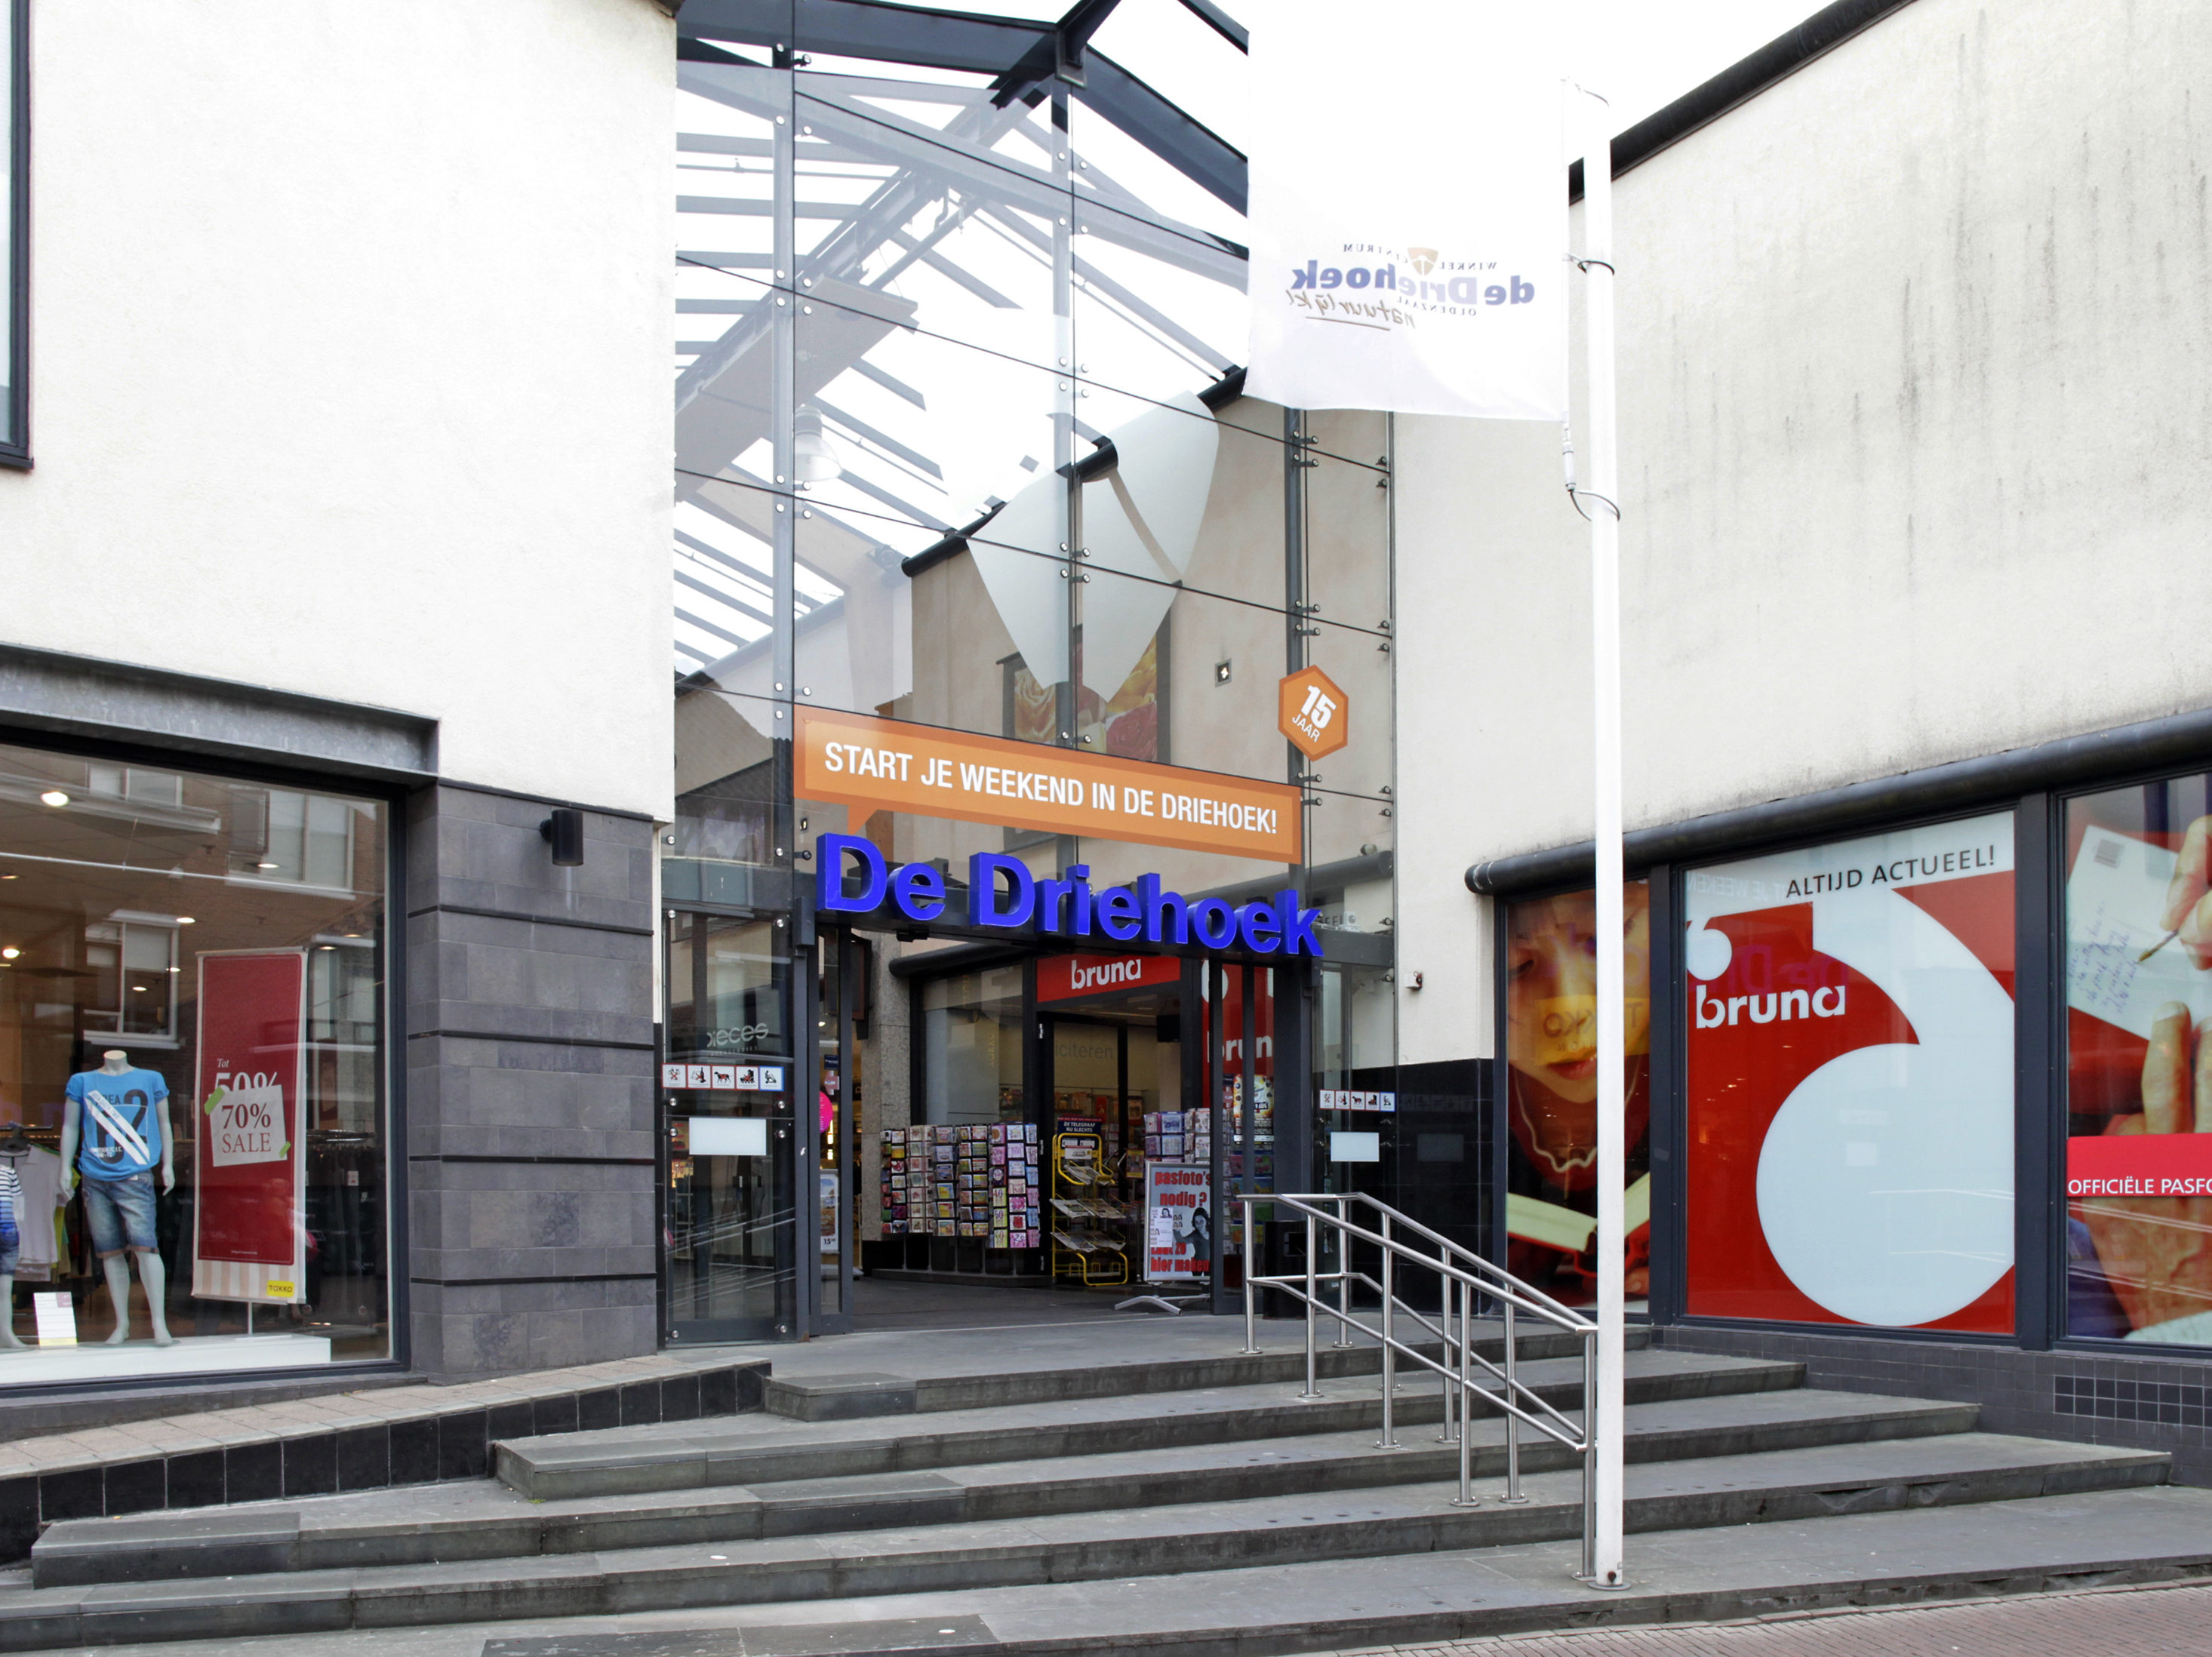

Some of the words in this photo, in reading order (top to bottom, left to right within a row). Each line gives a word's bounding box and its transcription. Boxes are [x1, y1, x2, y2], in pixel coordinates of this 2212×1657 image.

[1301, 684, 1337, 729] 15
[1291, 712, 1321, 742] JAAR
[825, 742, 913, 782] START
[921, 758, 952, 789] JE
[960, 763, 1084, 806] WEEKEND
[1091, 782, 1116, 812] IN
[1124, 787, 1154, 817] DE
[1161, 792, 1277, 835] DRIEHOEK!
[1786, 869, 1863, 898] ALTIJD
[1872, 844, 1995, 884] ACTUEEL!
[816, 832, 946, 921] De
[969, 852, 1324, 957] Driehoek
[1071, 959, 1141, 989] bruna
[1696, 984, 1846, 1029] bruna
[217, 1059, 230, 1068] Tot
[222, 1103, 272, 1130] 70%
[222, 1133, 272, 1154] SALE
[1159, 1191, 1196, 1207] nodig
[2068, 1176, 2155, 1194] OFFICIËLE
[1150, 1256, 1173, 1272] hier
[1174, 1256, 1211, 1272] maken
[269, 1284, 293, 1293] TAKKO
